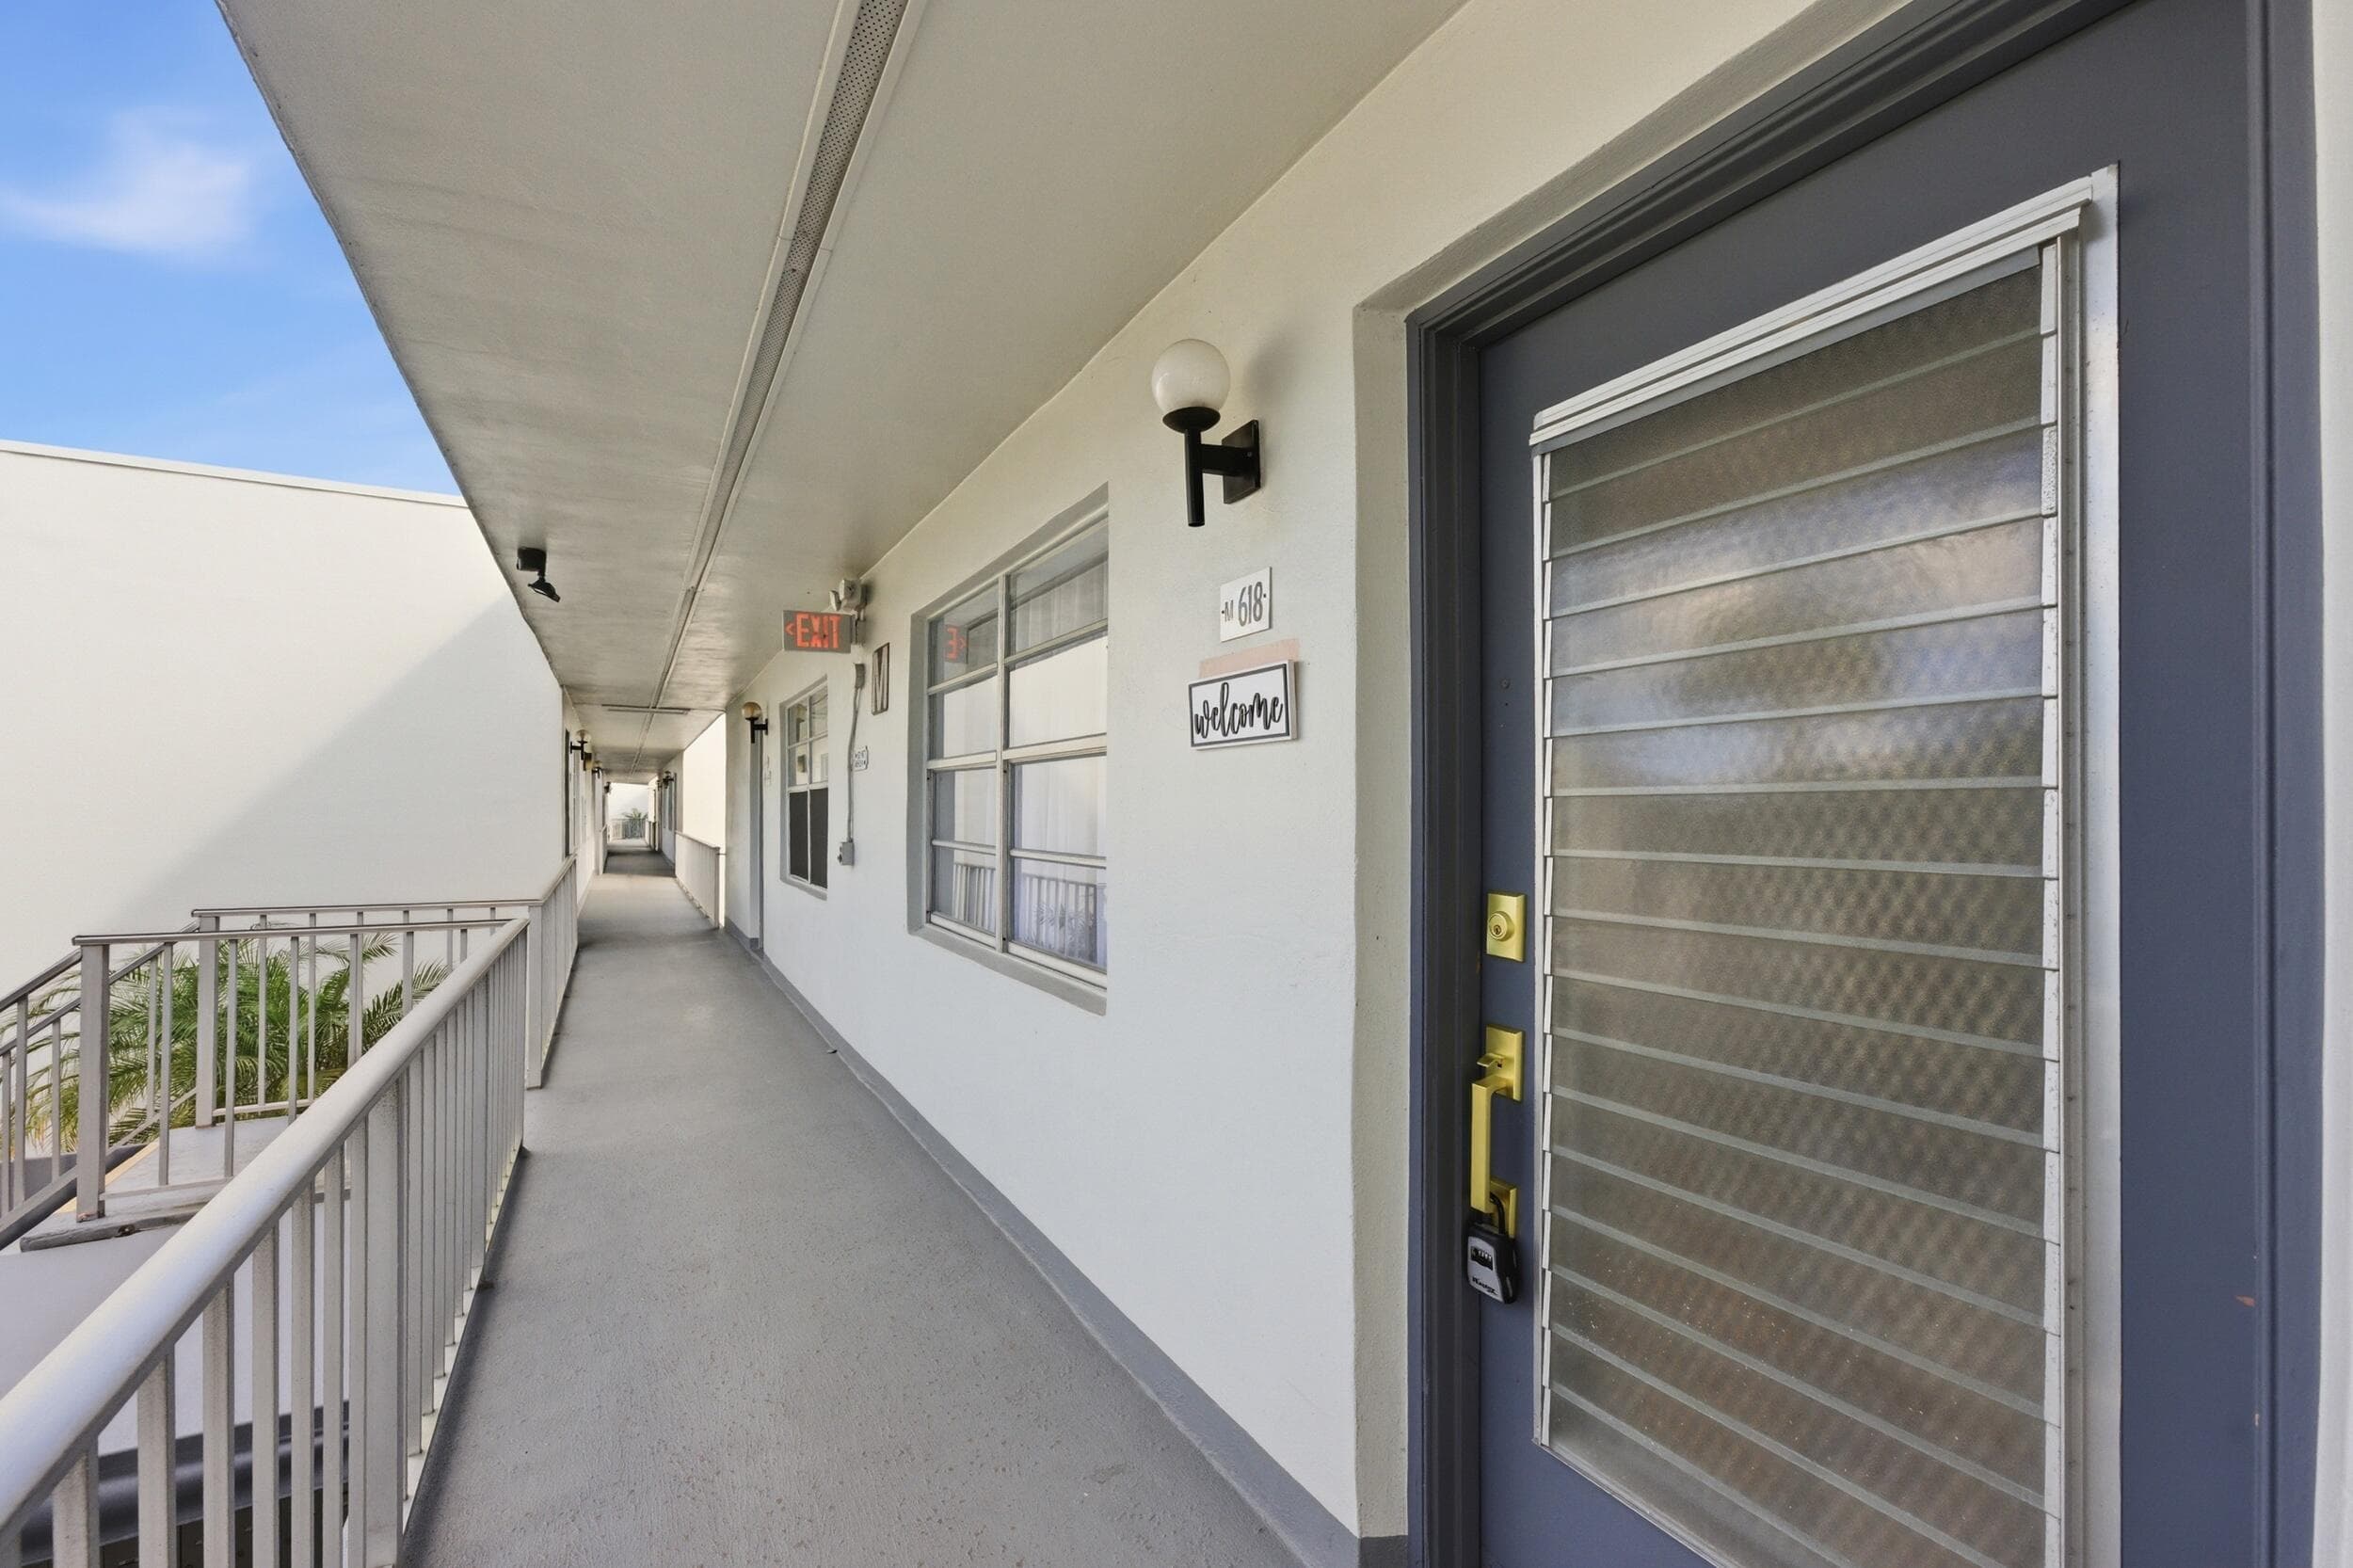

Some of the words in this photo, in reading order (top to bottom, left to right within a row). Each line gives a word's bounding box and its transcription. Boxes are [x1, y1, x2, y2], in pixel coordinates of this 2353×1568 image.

[1238, 581, 1263, 628] 618
[795, 612, 841, 649] EXIT
[1193, 681, 1284, 739] welcome
